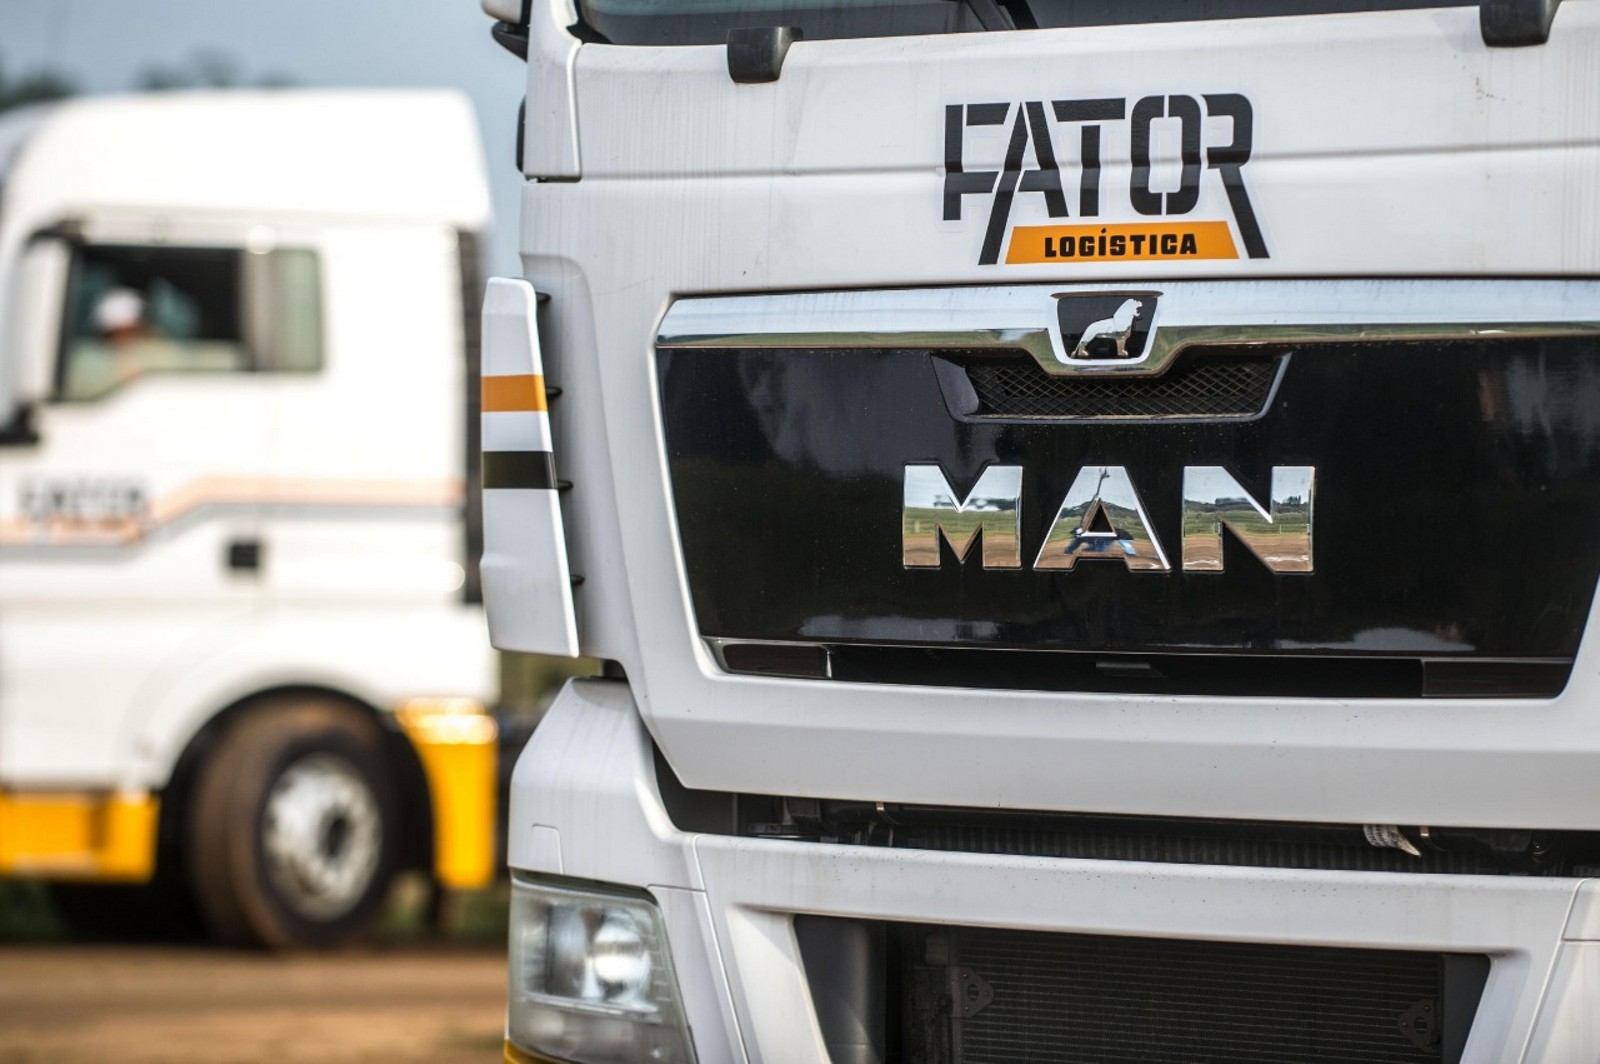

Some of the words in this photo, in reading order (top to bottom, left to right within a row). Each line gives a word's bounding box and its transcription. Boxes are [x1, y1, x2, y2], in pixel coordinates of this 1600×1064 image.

[943, 93, 1270, 266] FATOR
[1044, 227, 1198, 258] LOGÍSTICA
[903, 464, 1315, 574] MAN
